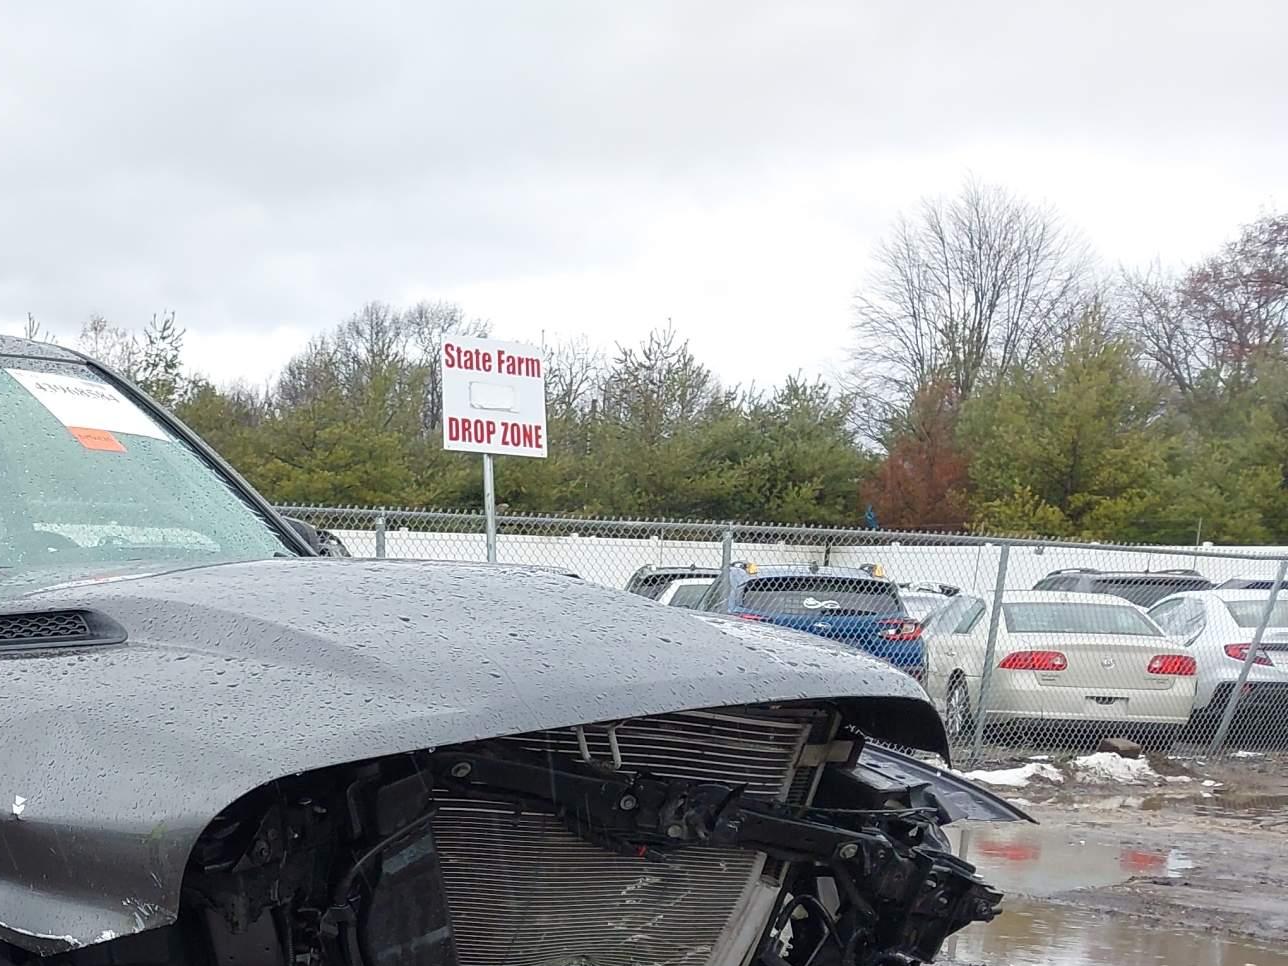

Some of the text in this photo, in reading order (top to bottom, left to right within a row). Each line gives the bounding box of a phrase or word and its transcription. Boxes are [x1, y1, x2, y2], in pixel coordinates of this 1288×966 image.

[444, 343, 541, 378] State Farm
[448, 417, 543, 448] DROP ZONE
